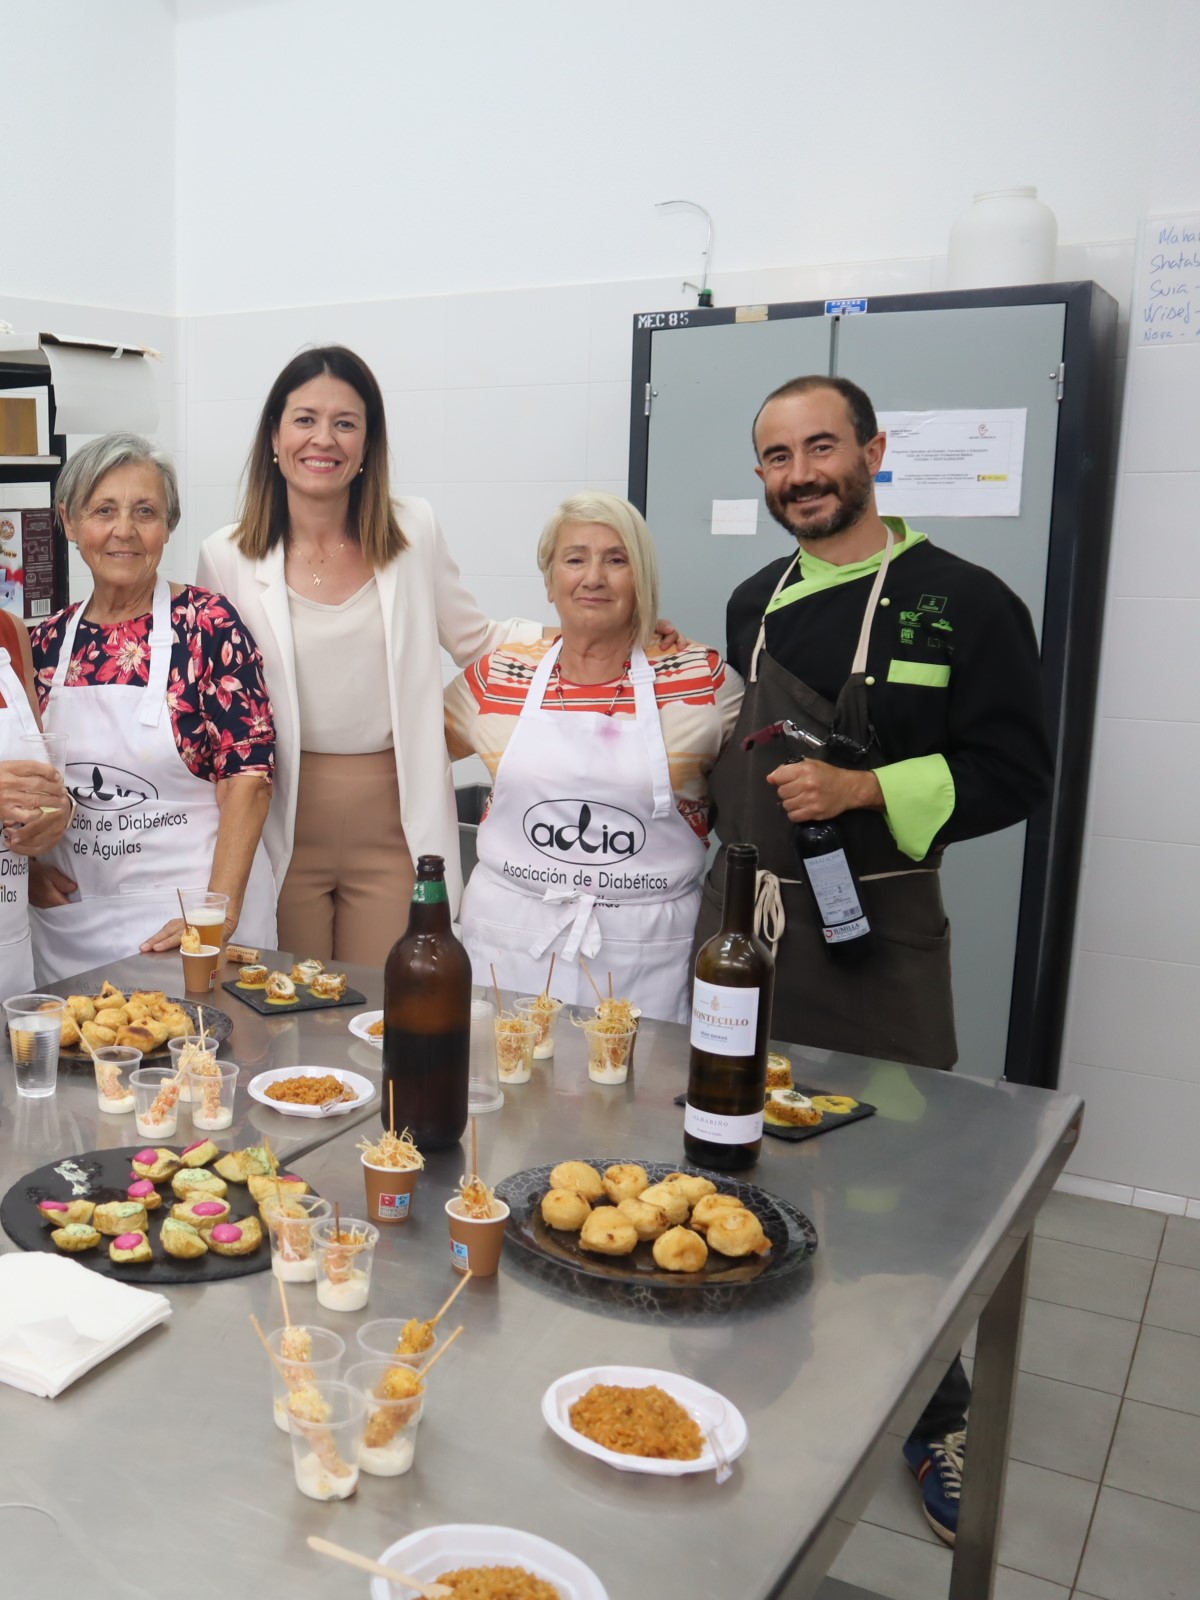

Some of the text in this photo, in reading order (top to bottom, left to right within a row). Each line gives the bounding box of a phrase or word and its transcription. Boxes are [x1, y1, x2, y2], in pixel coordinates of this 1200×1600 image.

[638, 314, 665, 328] MEC
[96, 815, 112, 832] de
[118, 812, 188, 831] Diabéticos
[531, 803, 634, 855] adia
[73, 835, 142, 861] de Águilas
[503, 860, 668, 890] Asociación de Diabéticos
